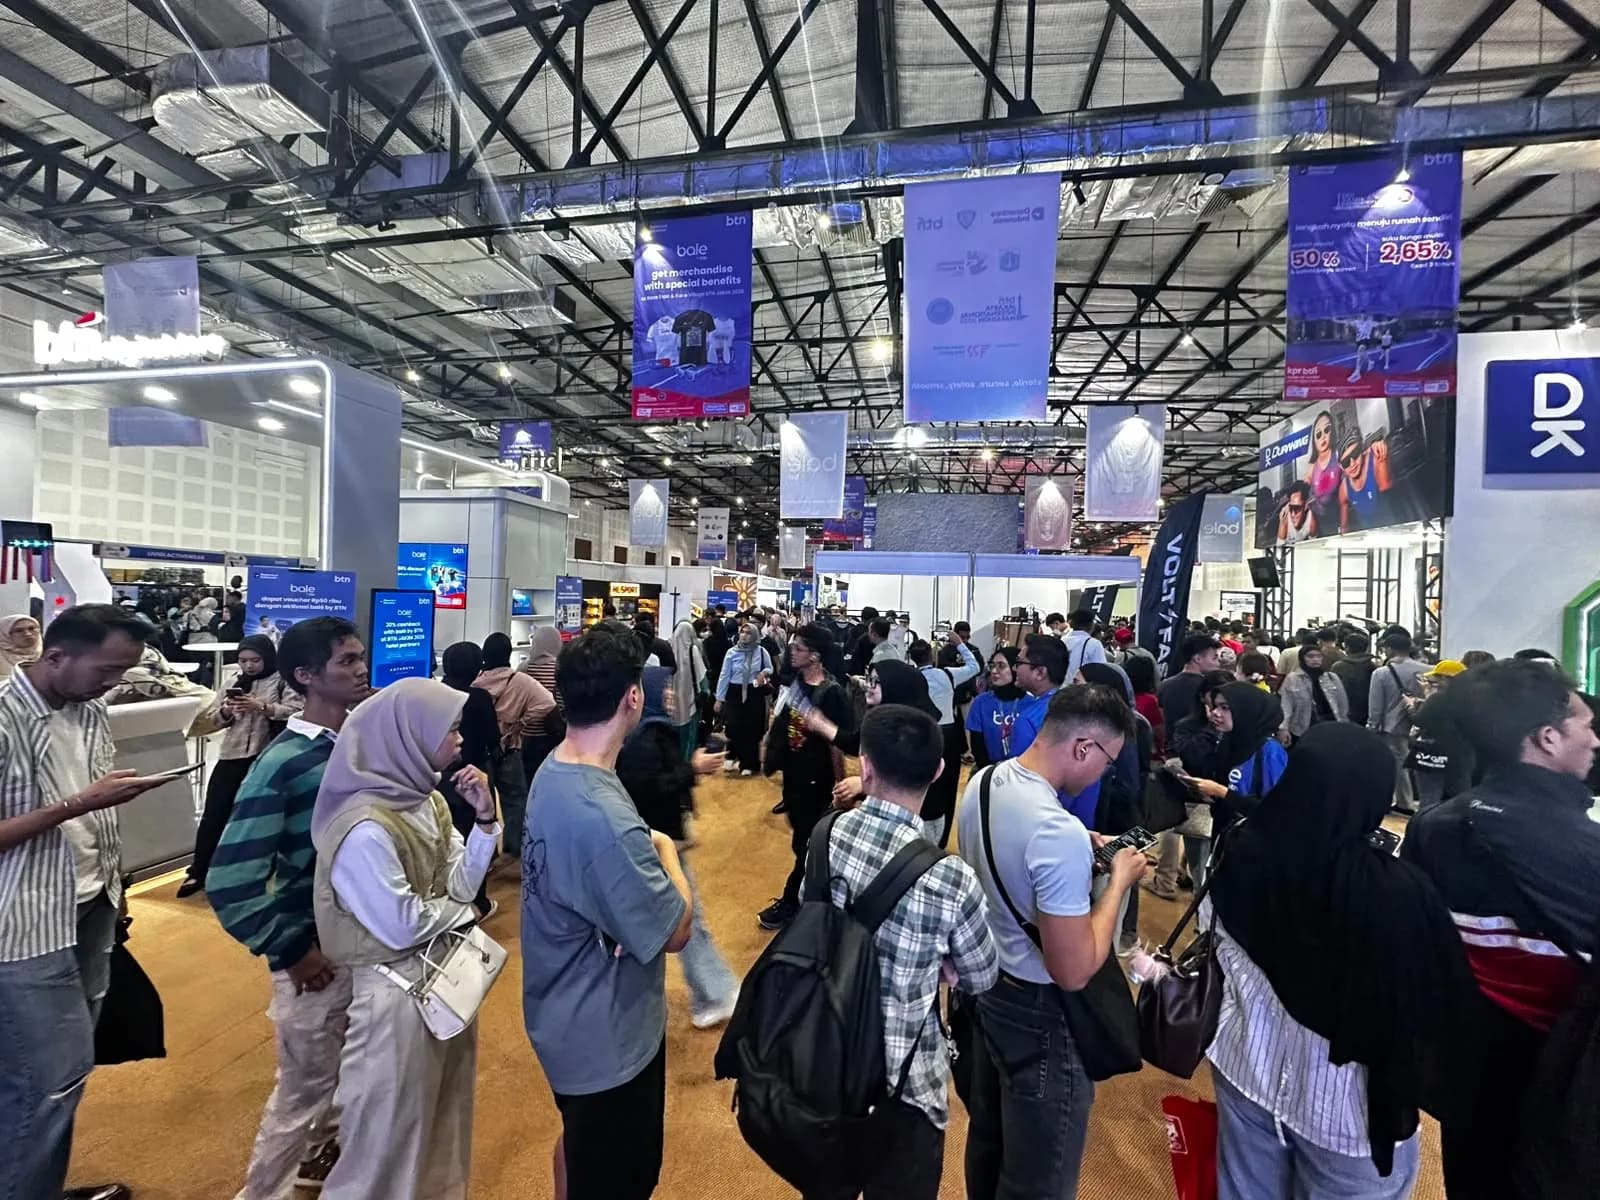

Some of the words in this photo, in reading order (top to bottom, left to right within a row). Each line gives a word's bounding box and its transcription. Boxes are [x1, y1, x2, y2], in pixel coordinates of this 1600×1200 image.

[1423, 153, 1453, 166] btn
[726, 216, 746, 227] btn
[1357, 218, 1390, 228] menuju
[1391, 216, 1421, 225] rumah
[1380, 240, 1452, 264] 2,65%
[1291, 249, 1340, 268] 50%
[651, 270, 669, 280] get
[669, 264, 733, 278] merchandise
[644, 280, 664, 291] with
[666, 278, 700, 291] special
[702, 275, 741, 286] benefits
[452, 546, 464, 554] btn
[334, 575, 351, 583] btn
[290, 584, 316, 593] bale
